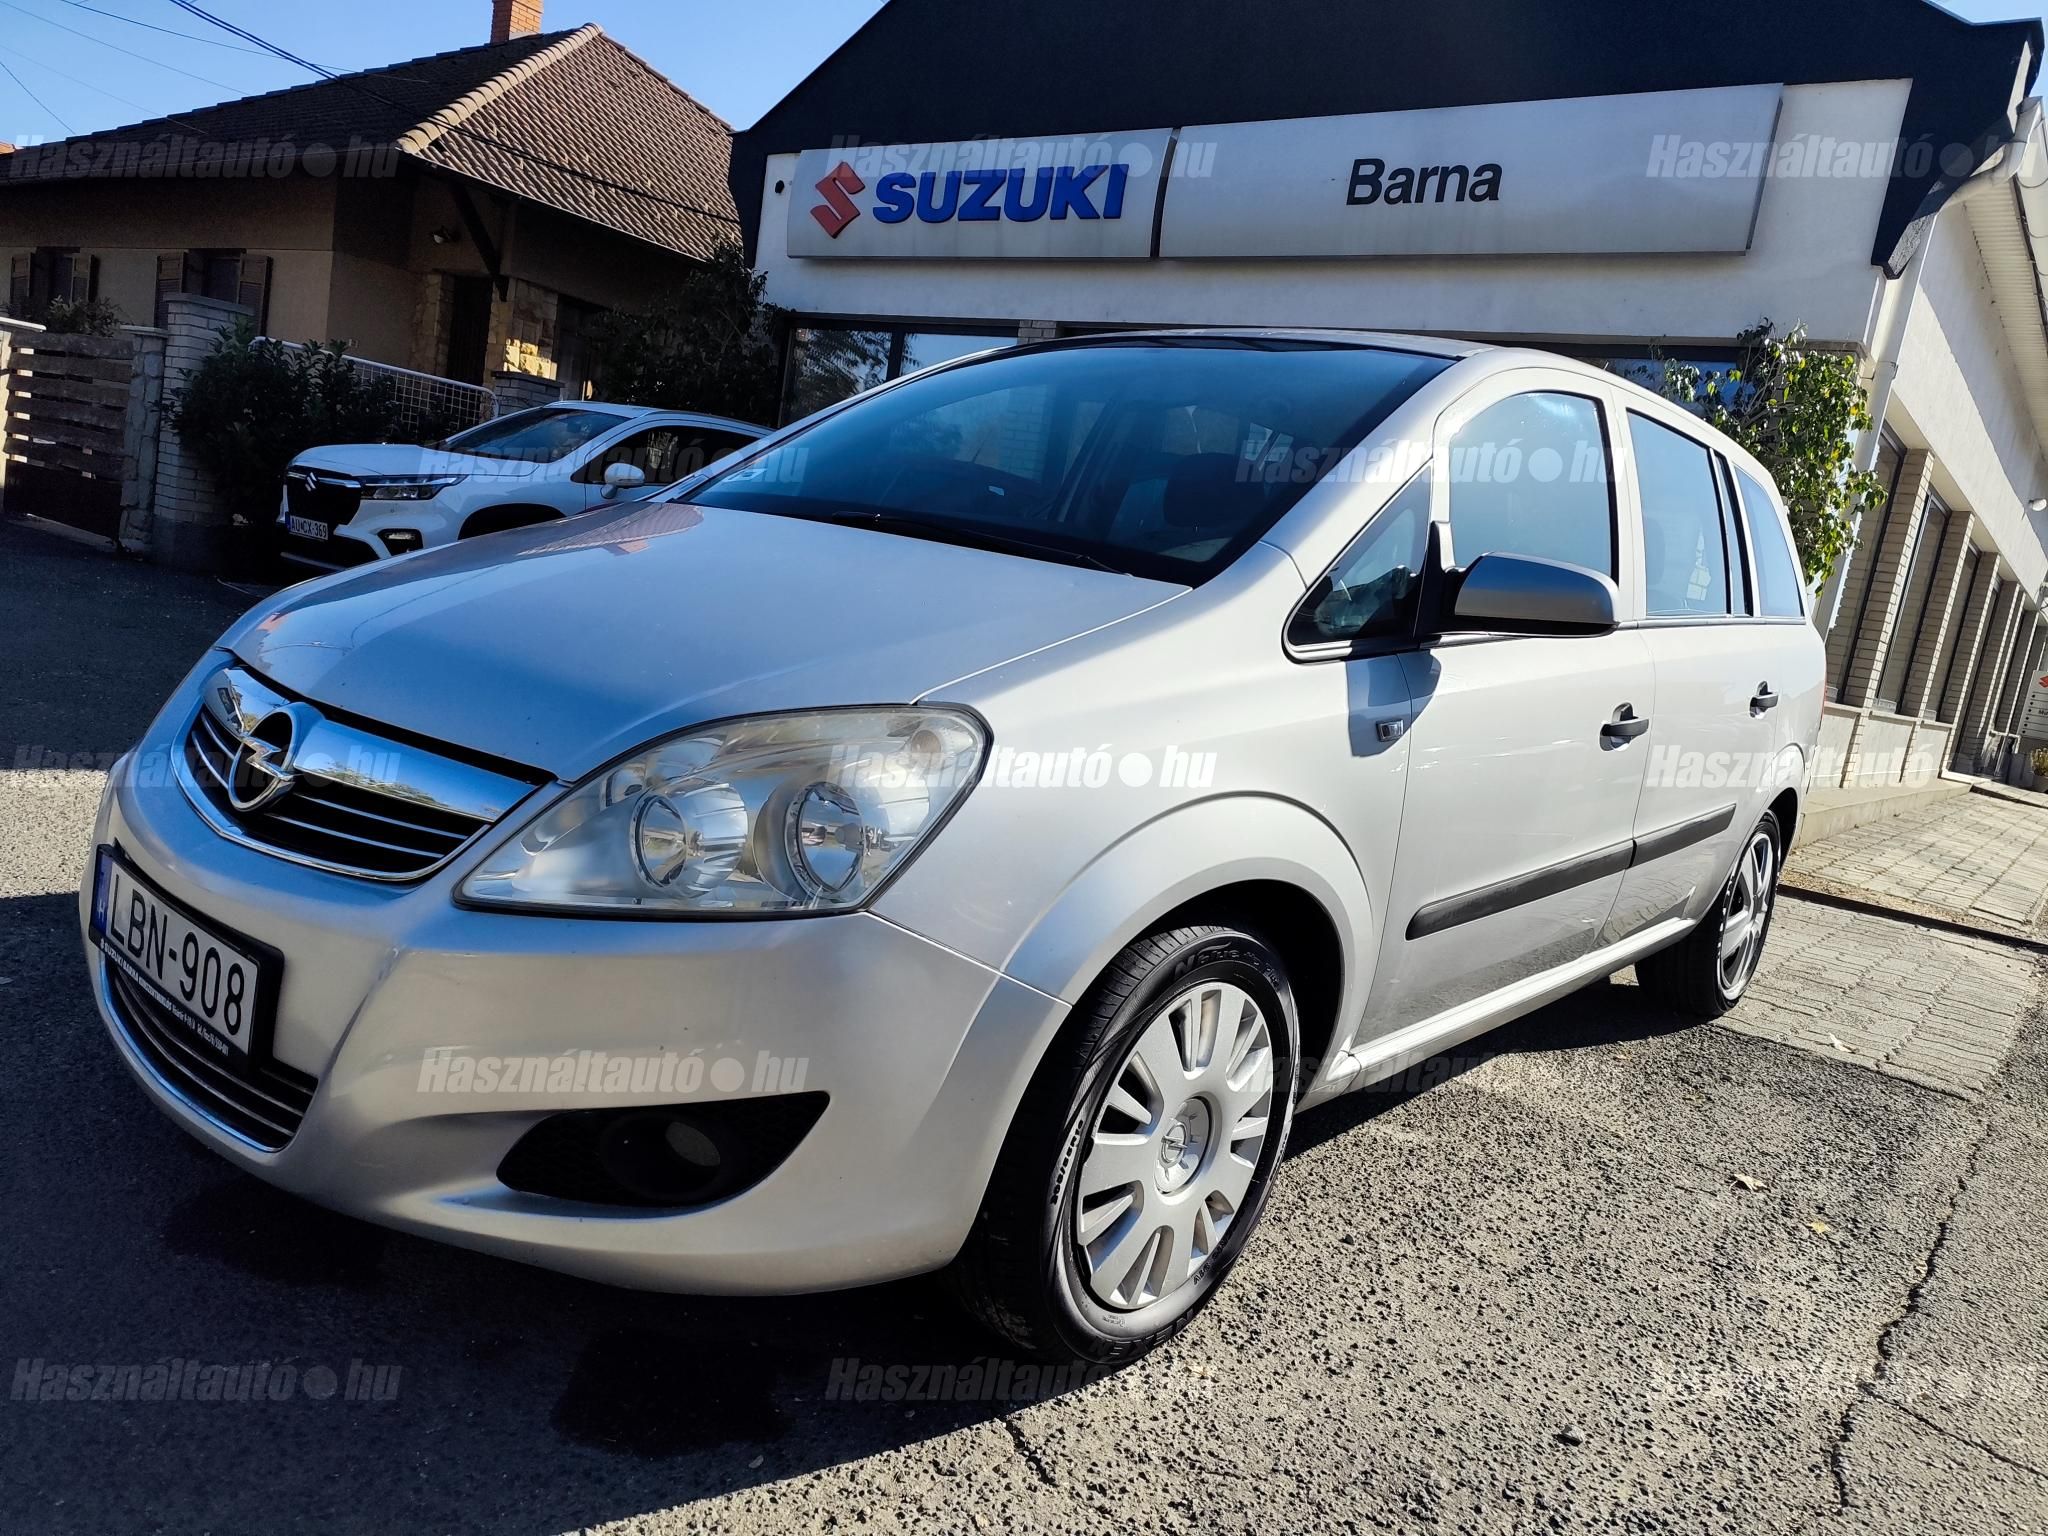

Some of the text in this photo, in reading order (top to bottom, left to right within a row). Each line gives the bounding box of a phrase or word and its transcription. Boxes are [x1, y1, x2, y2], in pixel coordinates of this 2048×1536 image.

[872, 163, 1129, 224] SUZUKI
[1346, 158, 1503, 206] Barna
[111, 874, 245, 1036] LBN-908
